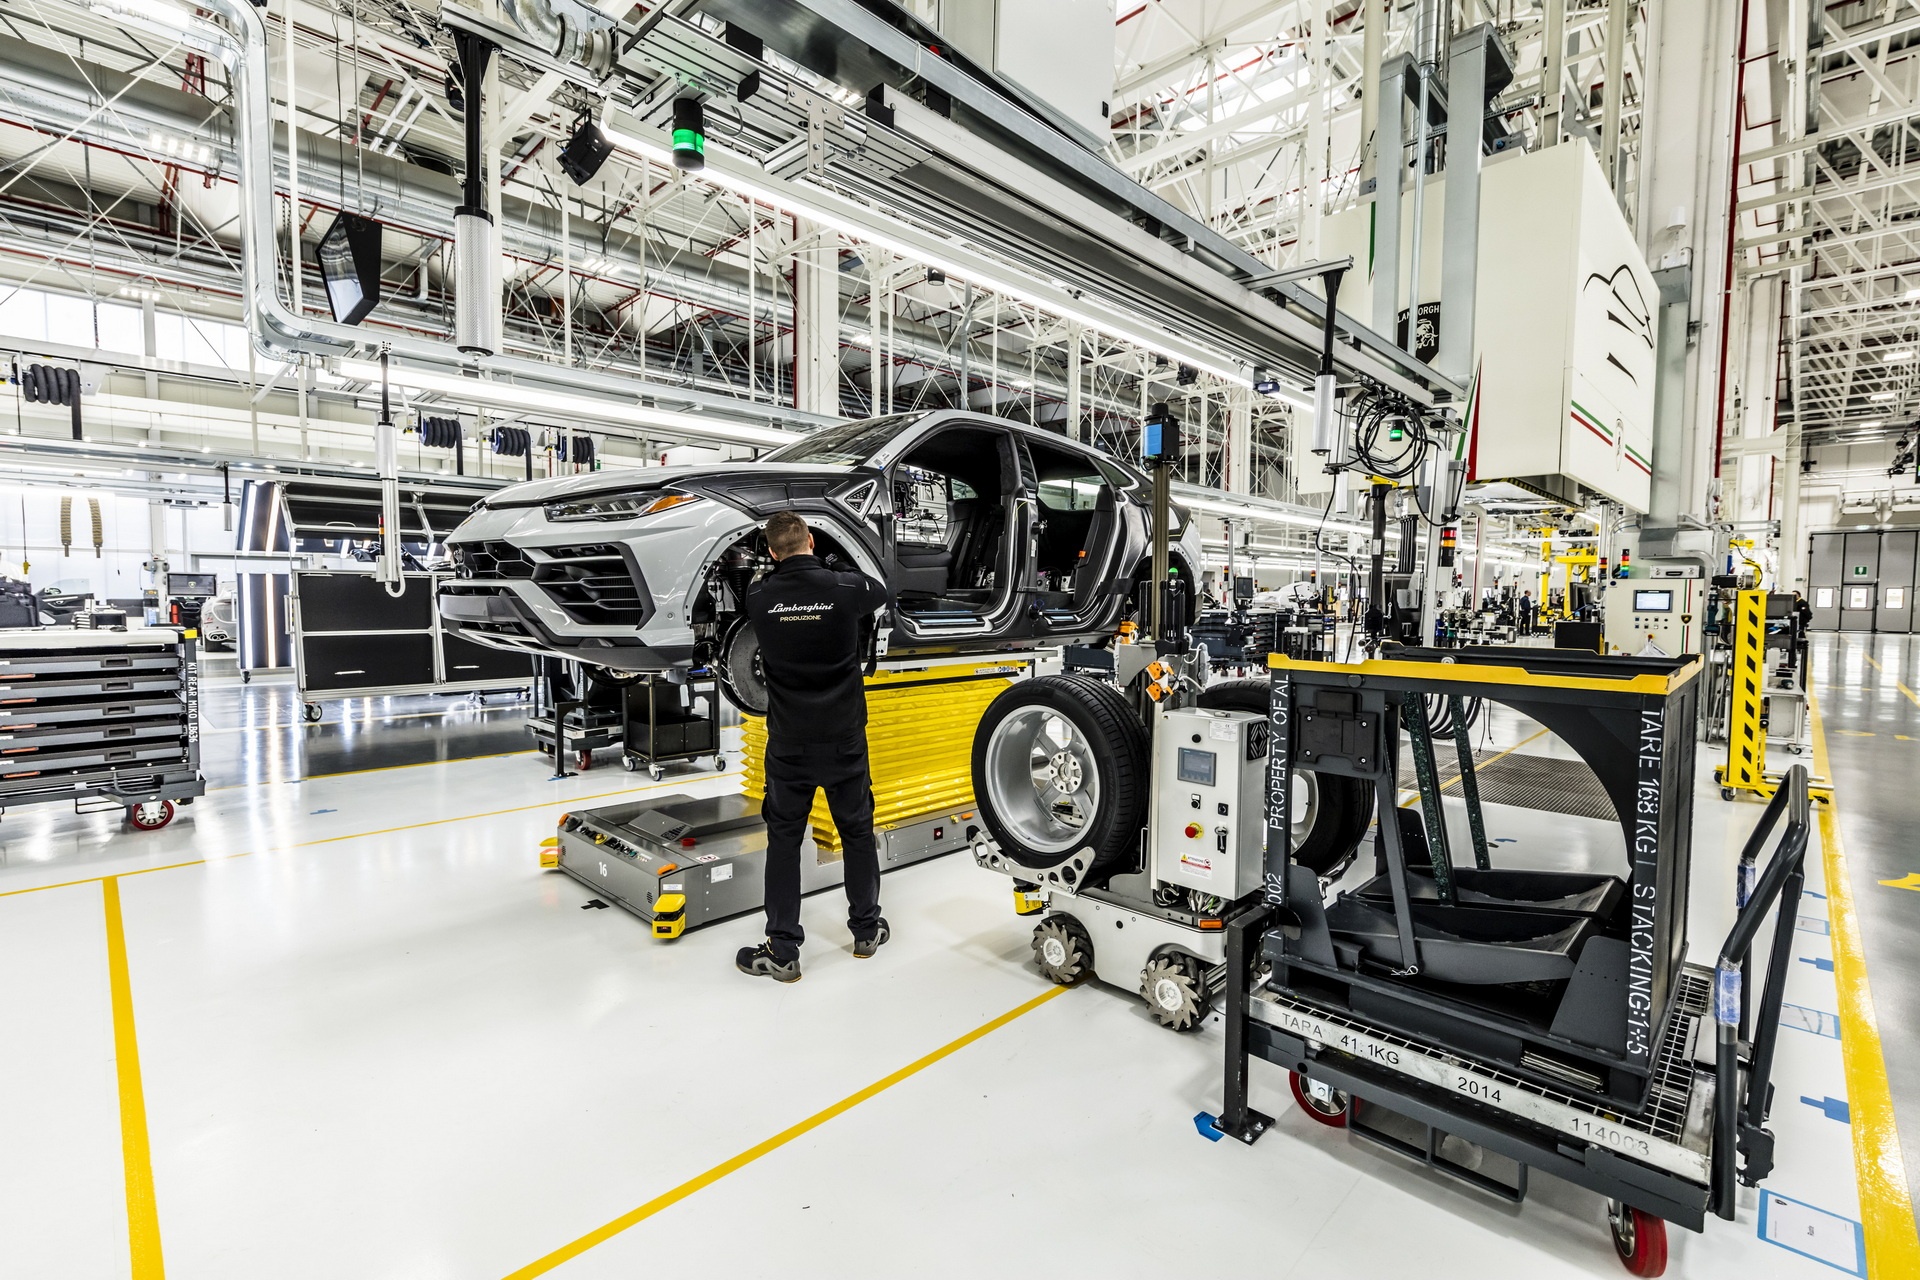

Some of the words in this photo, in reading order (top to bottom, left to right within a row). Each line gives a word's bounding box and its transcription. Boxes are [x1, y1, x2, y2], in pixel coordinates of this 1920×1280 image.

[1398, 305, 1440, 324] LAORGH
[768, 603, 834, 614] Lamborghini
[187, 662, 197, 674] KIT
[188, 677, 197, 697] REAR
[1274, 674, 1289, 697] AL
[188, 700, 198, 719] MIKO
[1272, 699, 1288, 725] OF
[188, 722, 198, 743] LB636
[1639, 707, 1664, 769] TARE
[1269, 731, 1286, 830] PROPERTY
[599, 862, 607, 877] 16
[1282, 1013, 1323, 1038] TARA
[1340, 1035, 1399, 1064] 41.1KG
[1457, 1077, 1501, 1102] 2014
